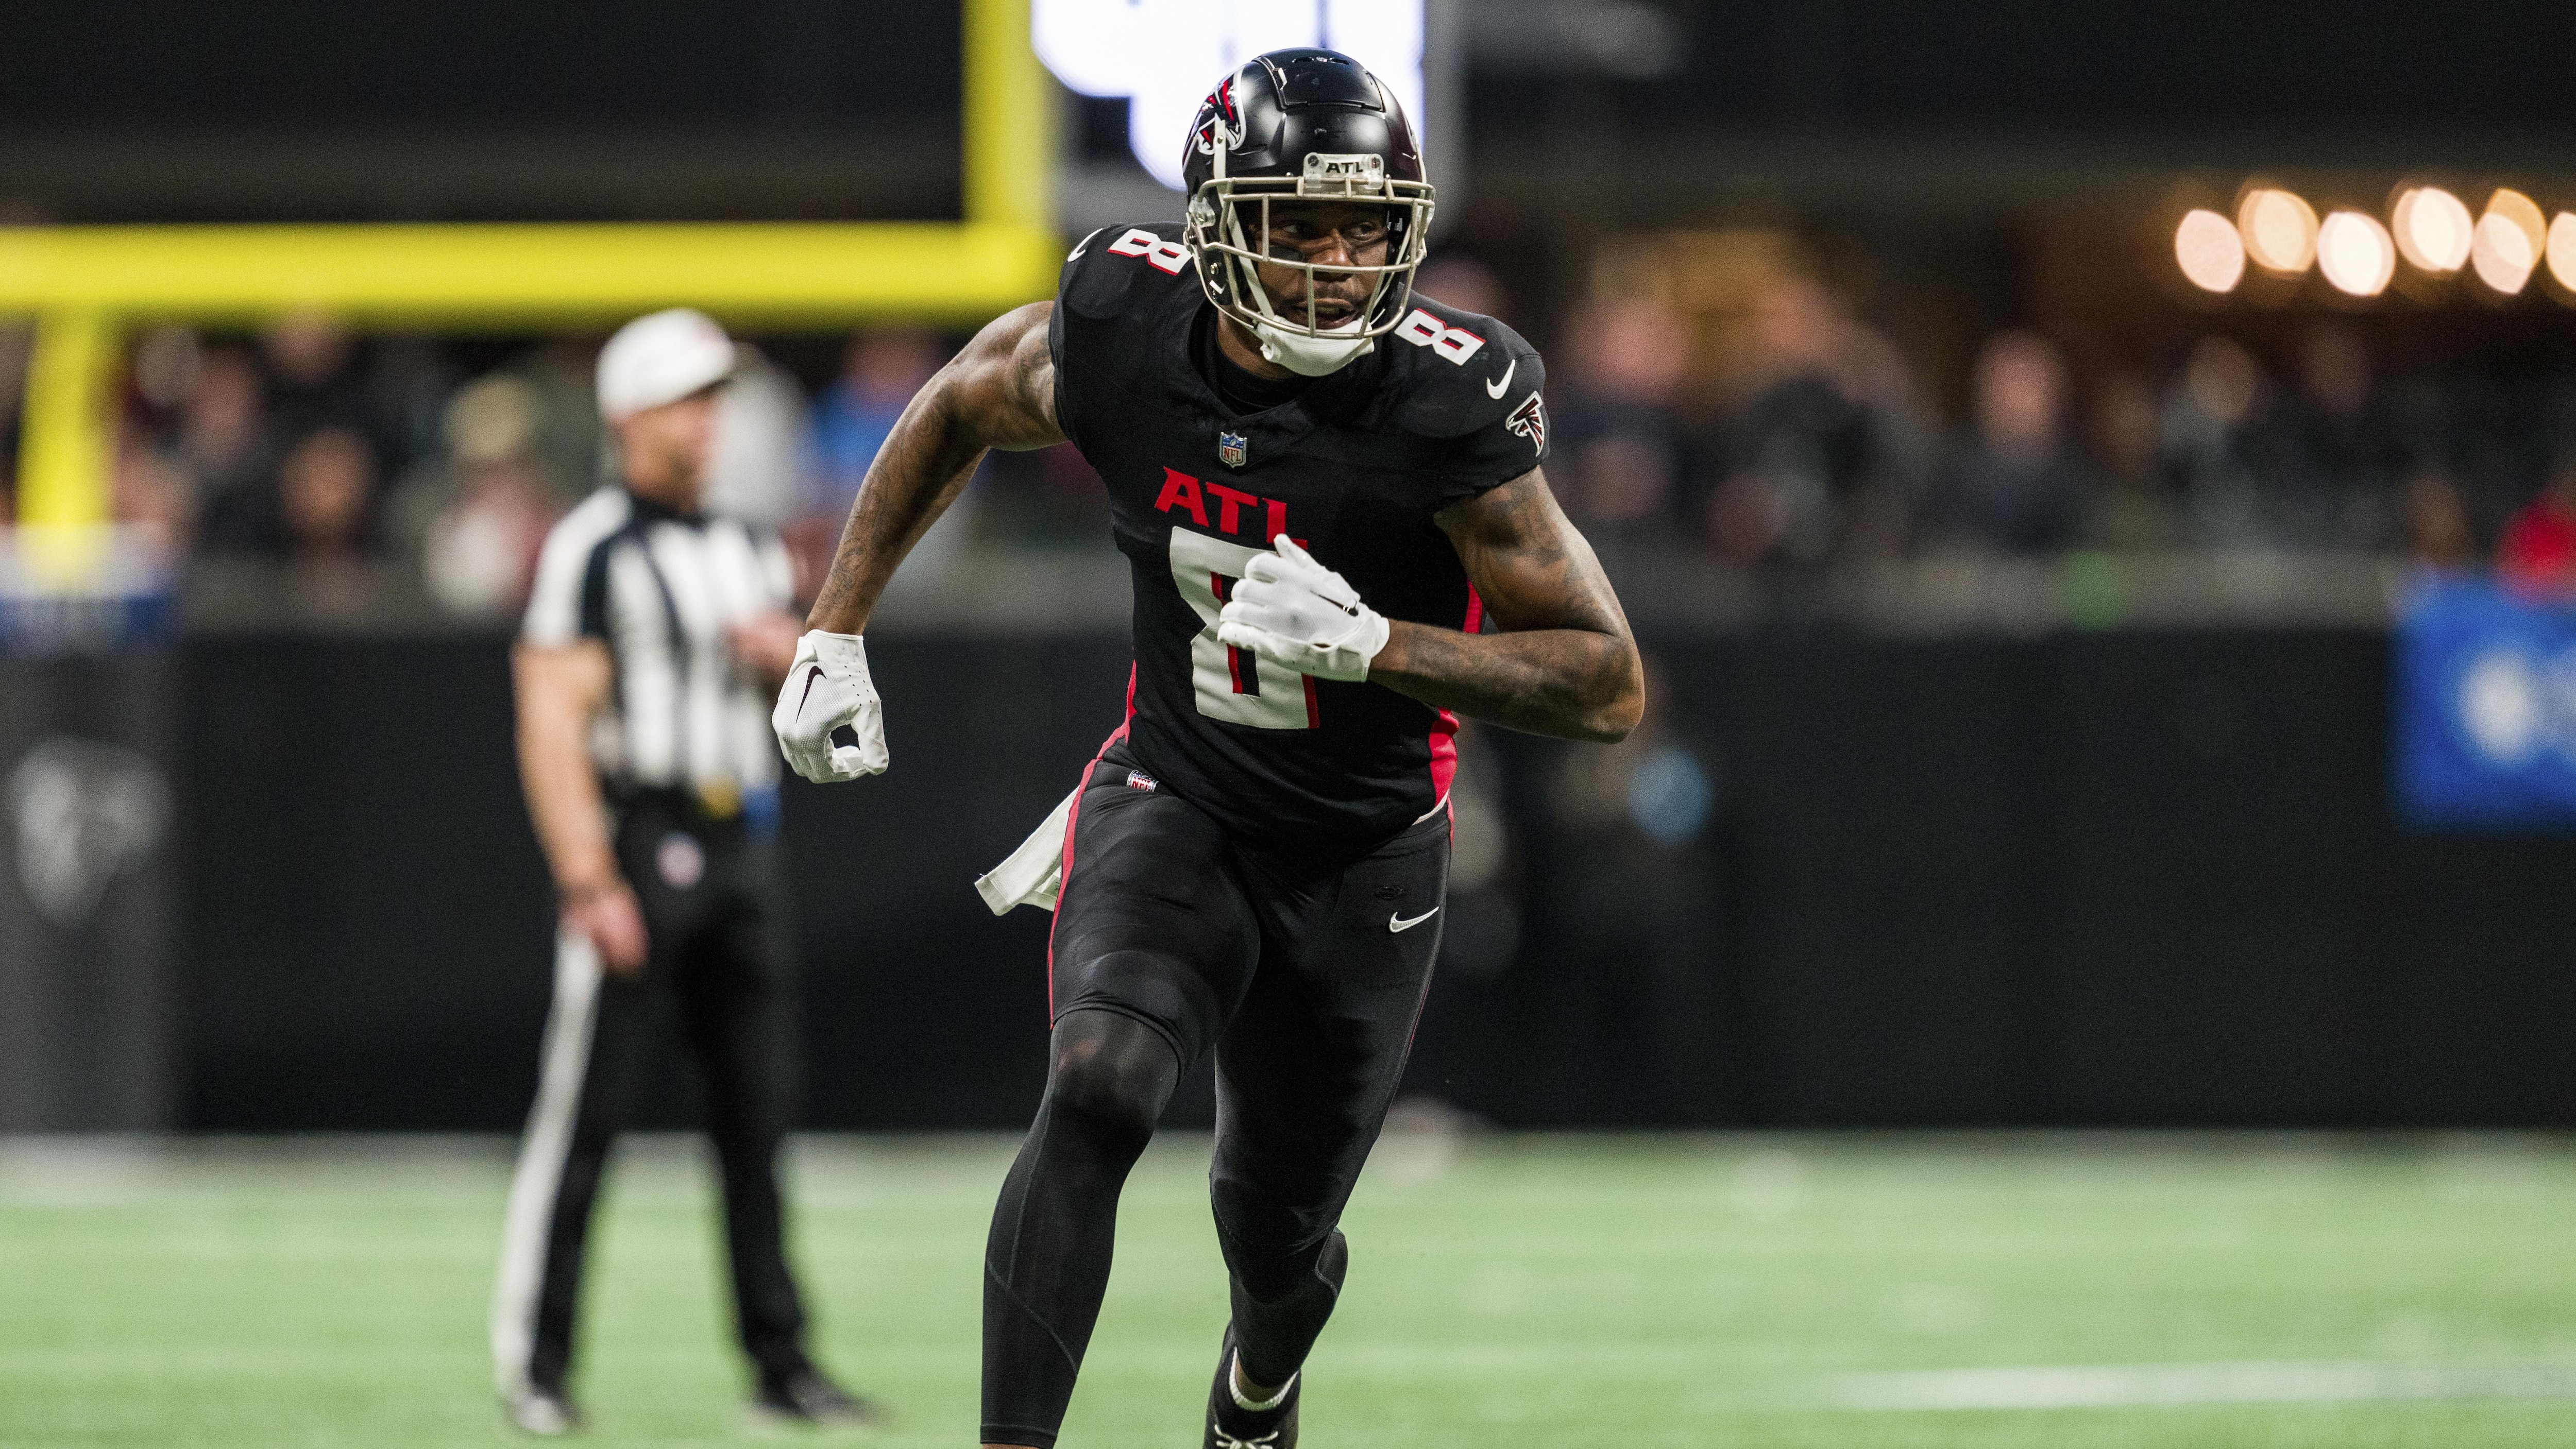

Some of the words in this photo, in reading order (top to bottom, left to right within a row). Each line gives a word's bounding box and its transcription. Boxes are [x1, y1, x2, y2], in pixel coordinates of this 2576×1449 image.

[1326, 162, 1363, 174] ATL
[1107, 228, 1193, 276] 8
[1394, 308, 1486, 366] 8
[1224, 447, 1241, 462] NFL
[1154, 466, 1308, 550] ATL
[1130, 777, 1150, 792] NFL
